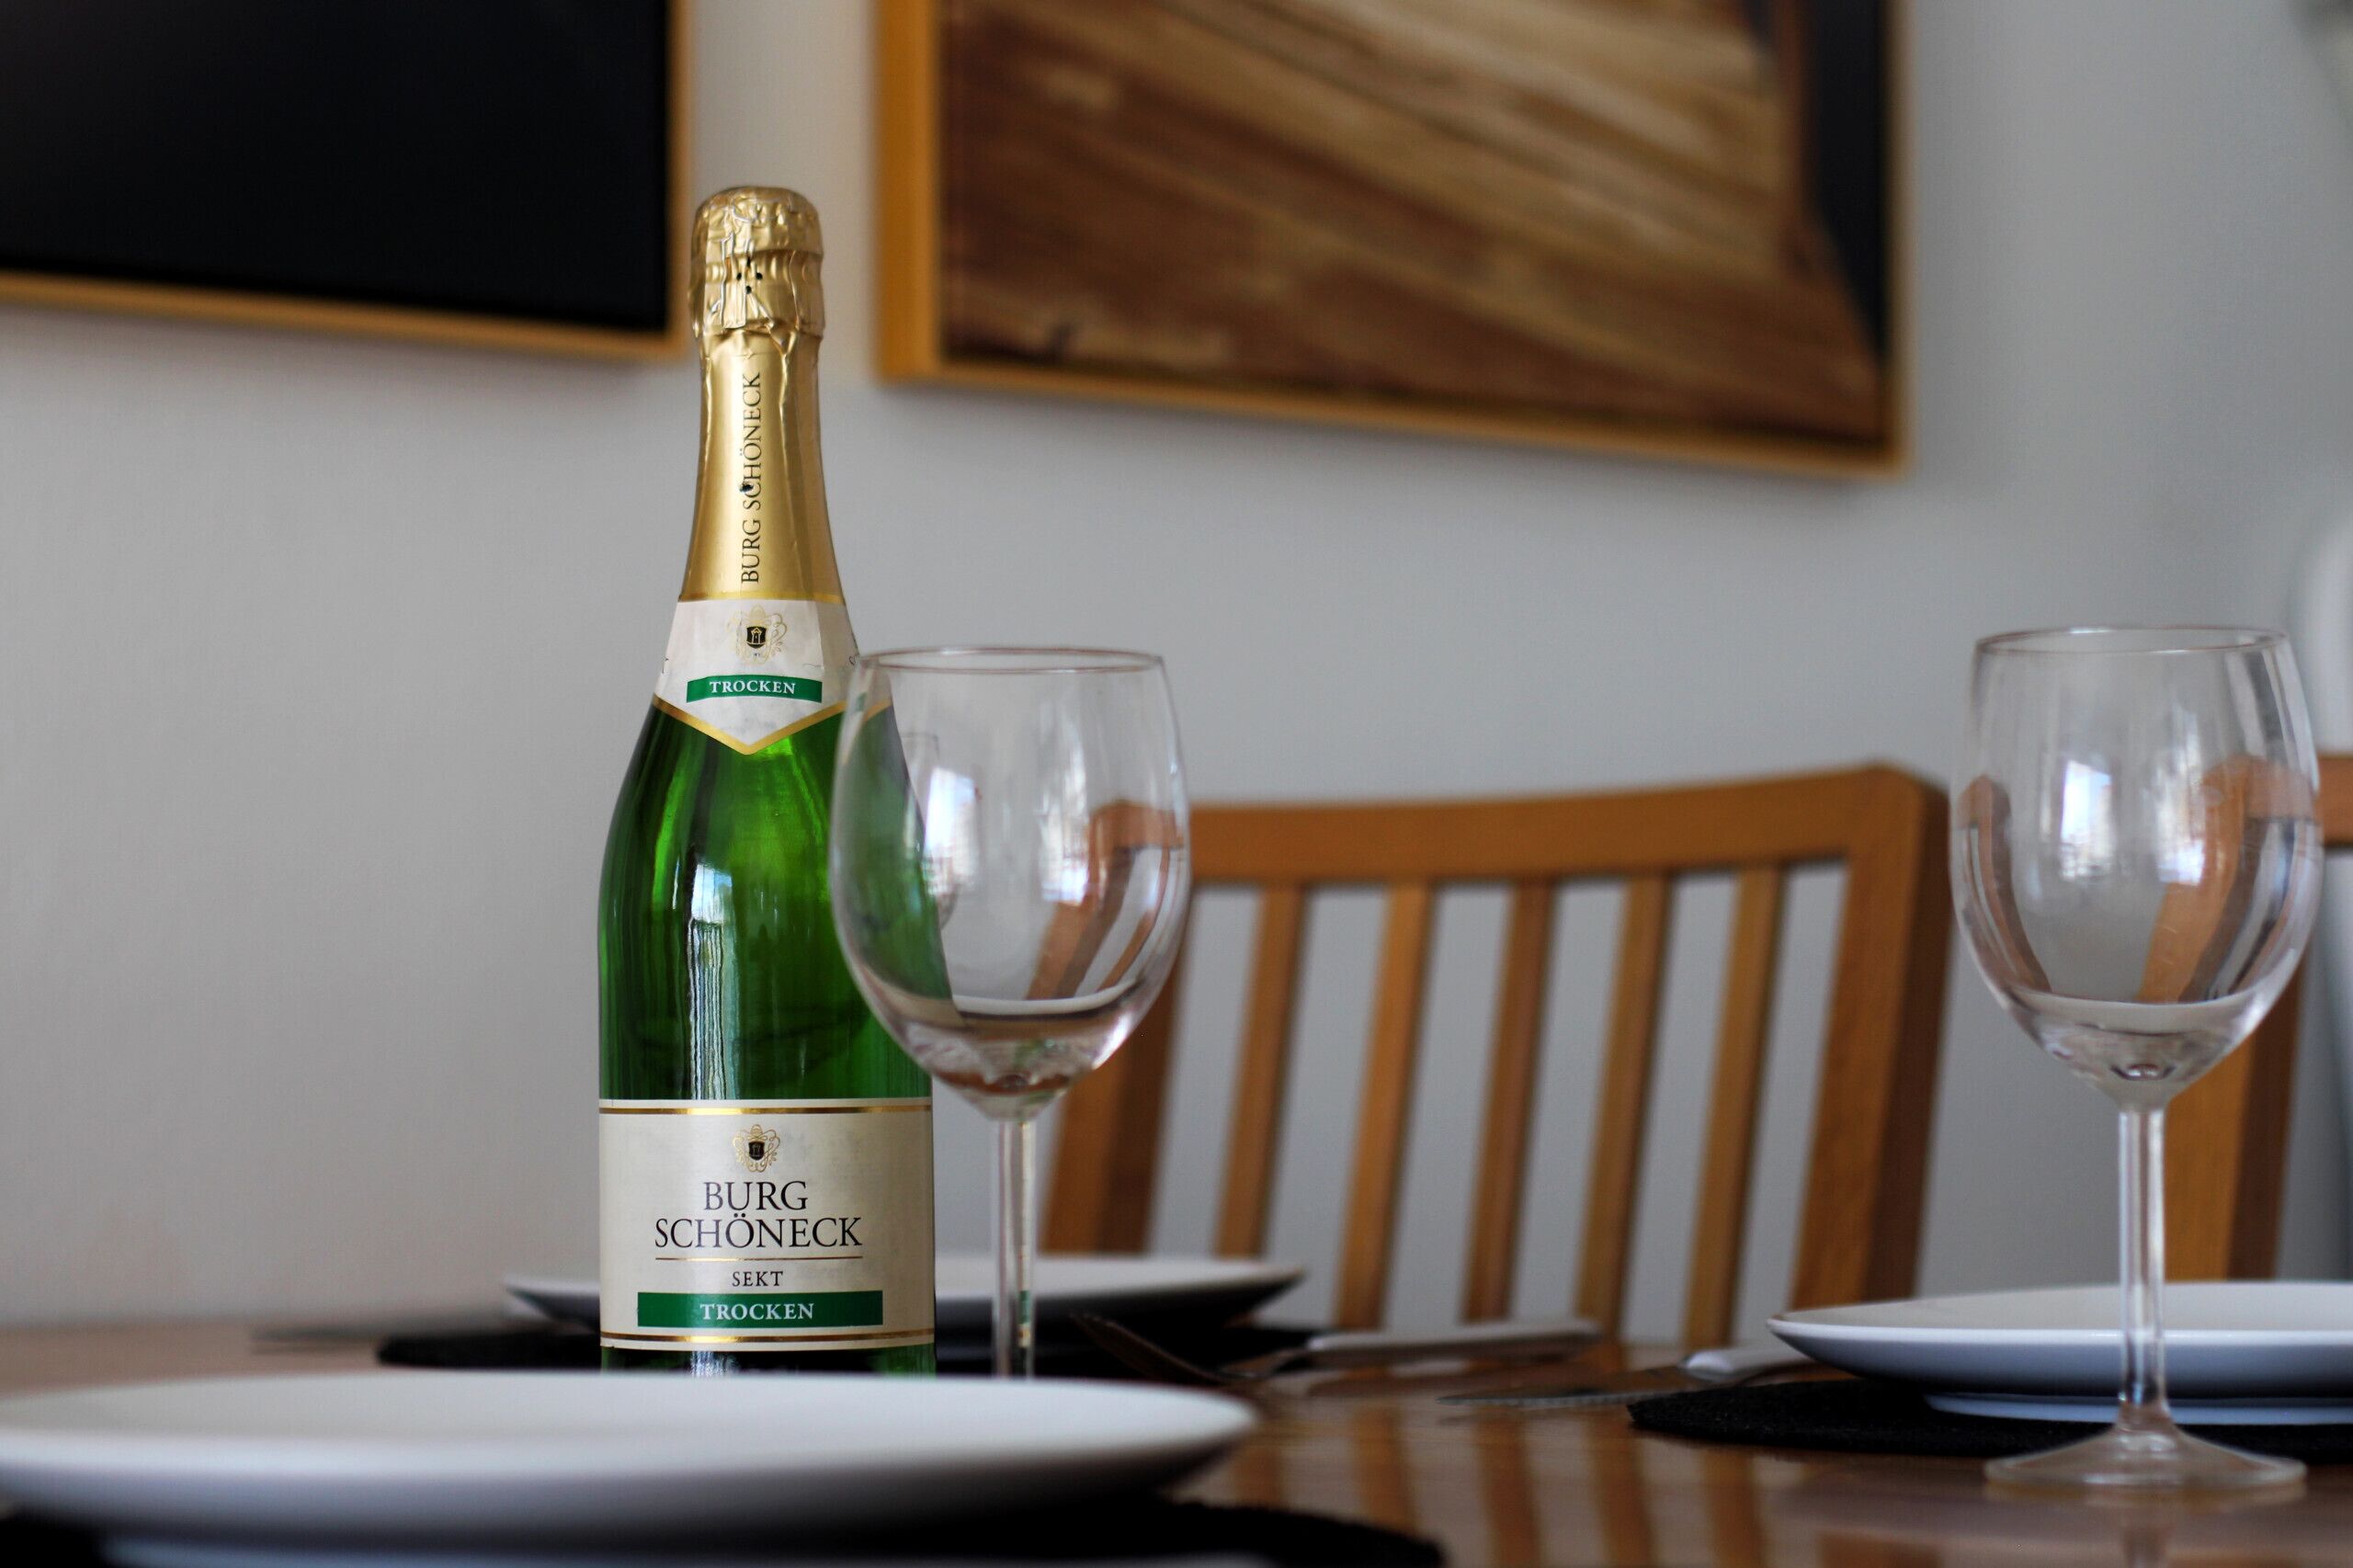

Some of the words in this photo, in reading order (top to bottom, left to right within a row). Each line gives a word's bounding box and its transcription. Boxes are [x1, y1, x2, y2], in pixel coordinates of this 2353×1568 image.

[739, 372, 762, 510] SCHÖNECK
[742, 519, 761, 585] BURG
[709, 679, 796, 695] TROCKEN
[703, 1180, 809, 1211] BURG
[654, 1212, 863, 1249] SCHÖNECK
[732, 1270, 784, 1288] SEKT
[699, 1302, 814, 1321] TROCKEN
